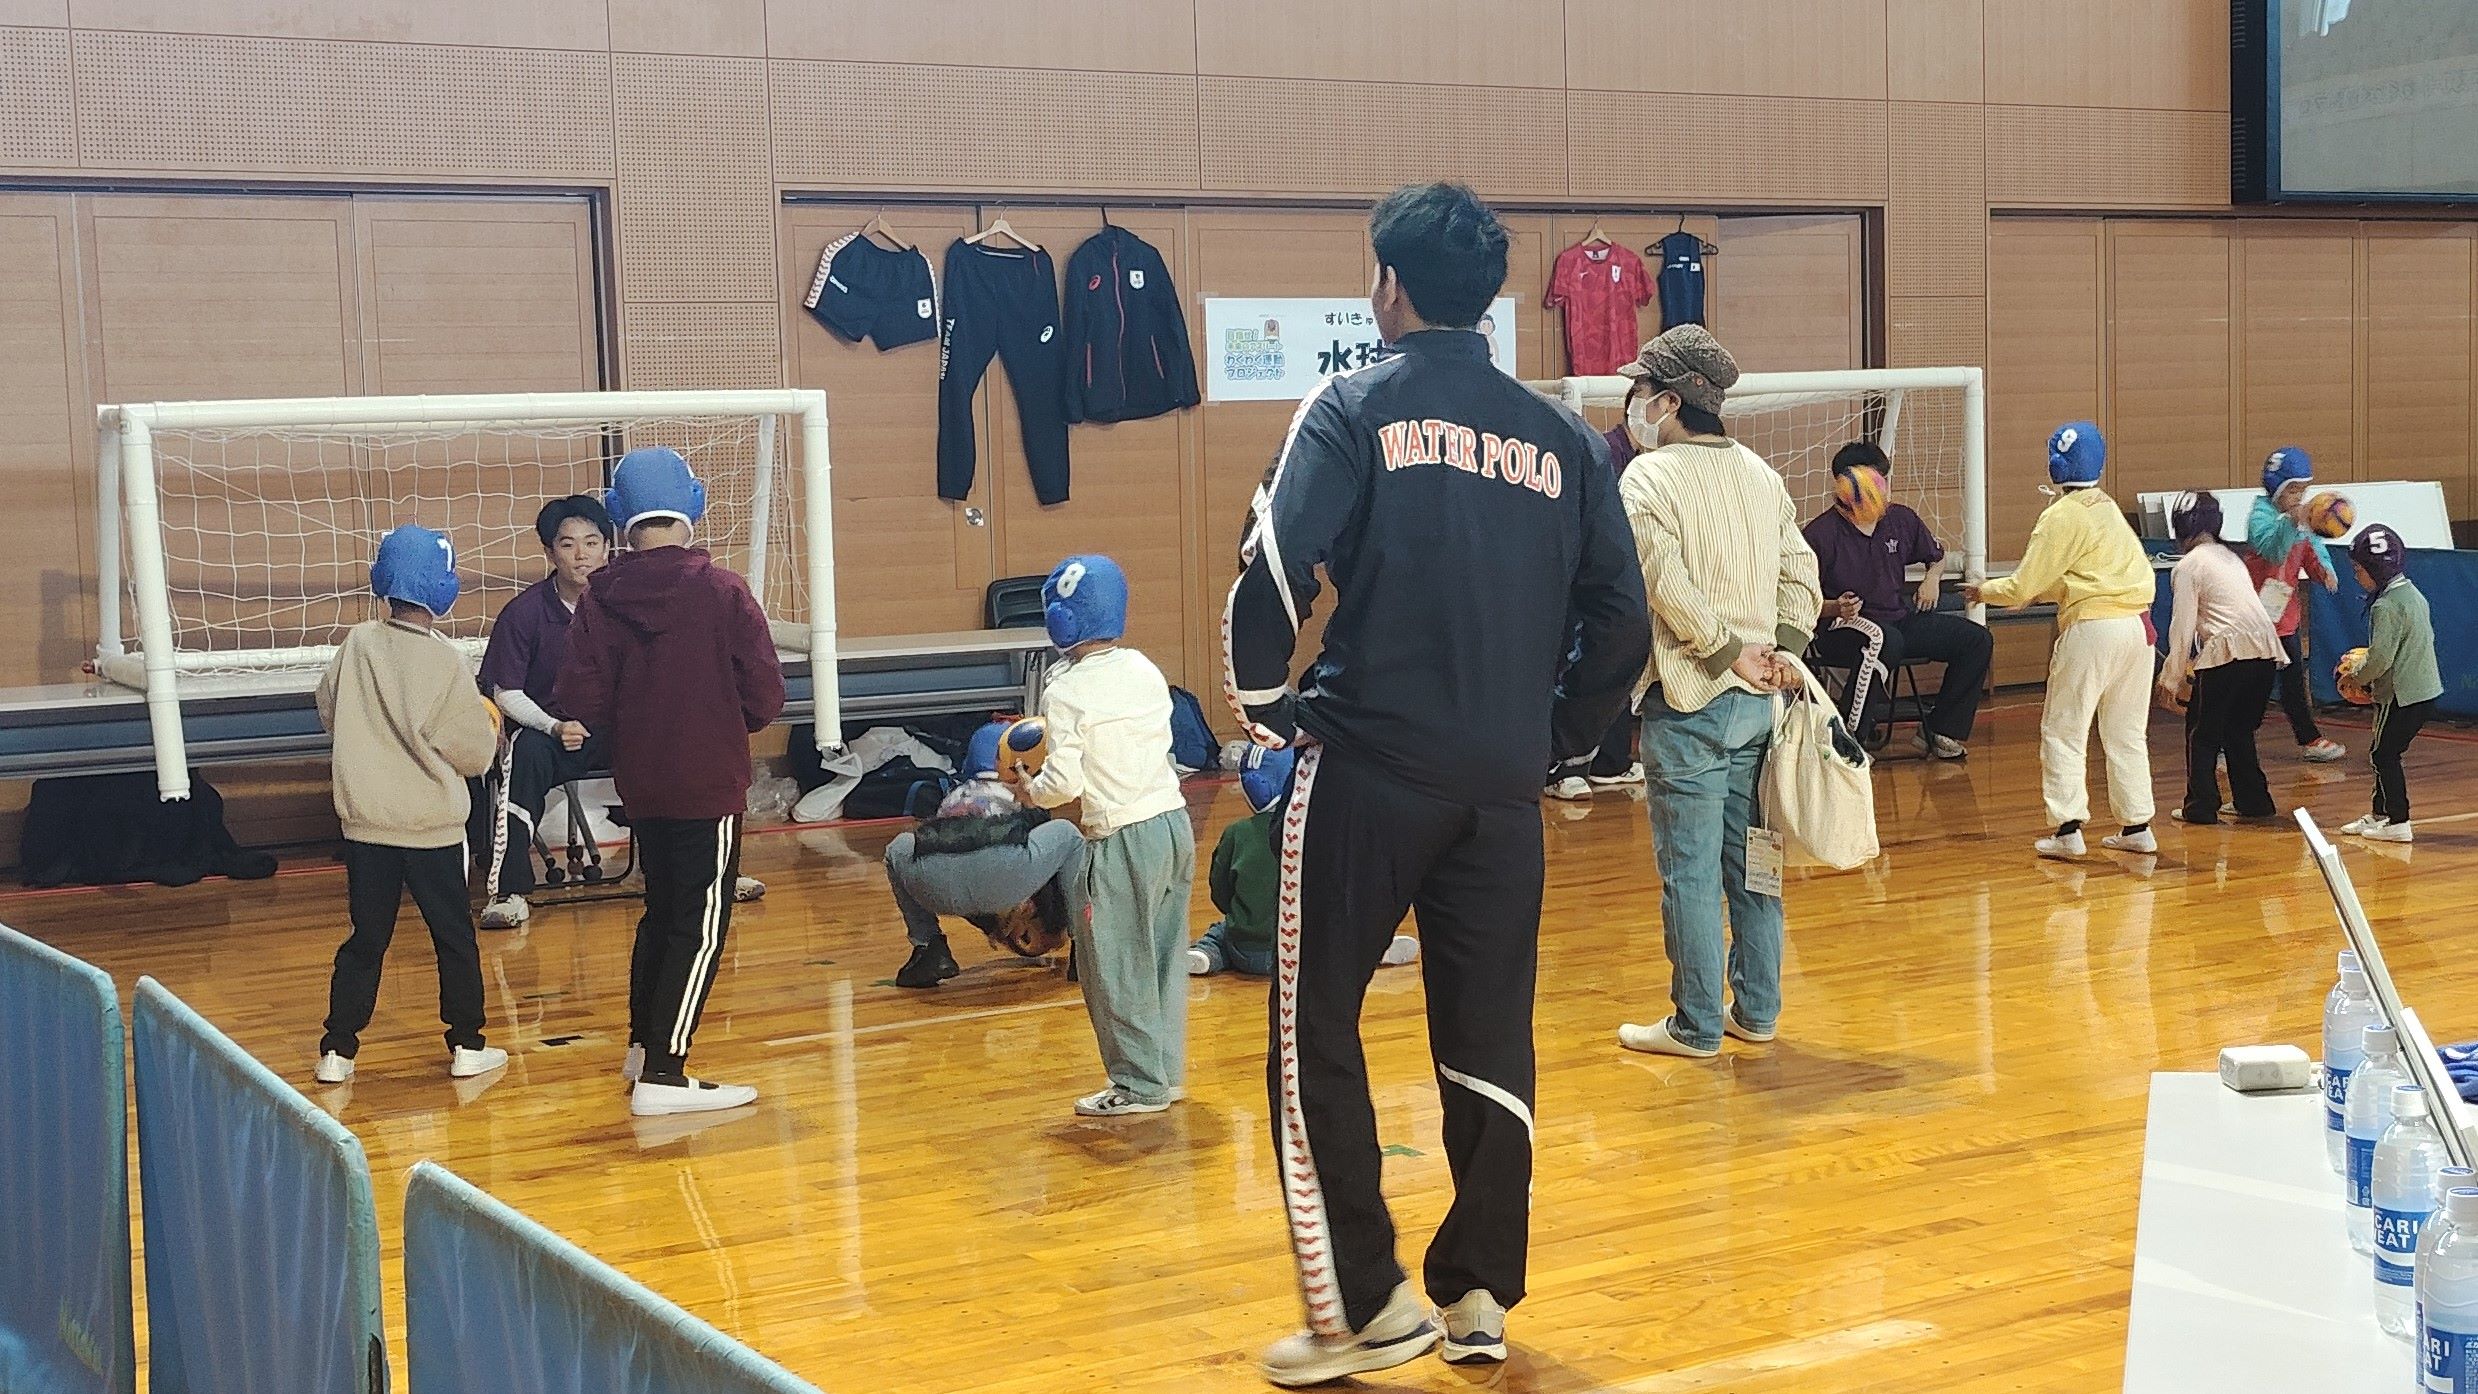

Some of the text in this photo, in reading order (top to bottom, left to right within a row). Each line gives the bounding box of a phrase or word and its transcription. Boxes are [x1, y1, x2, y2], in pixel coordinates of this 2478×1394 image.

[2057, 428, 2078, 453] 9
[1377, 419, 1562, 499] WATER POLO
[2368, 530, 2389, 554] 5
[1056, 562, 1087, 599] 8
[2374, 1214, 2419, 1235] CARI
[2374, 1229, 2411, 1249] EAT
